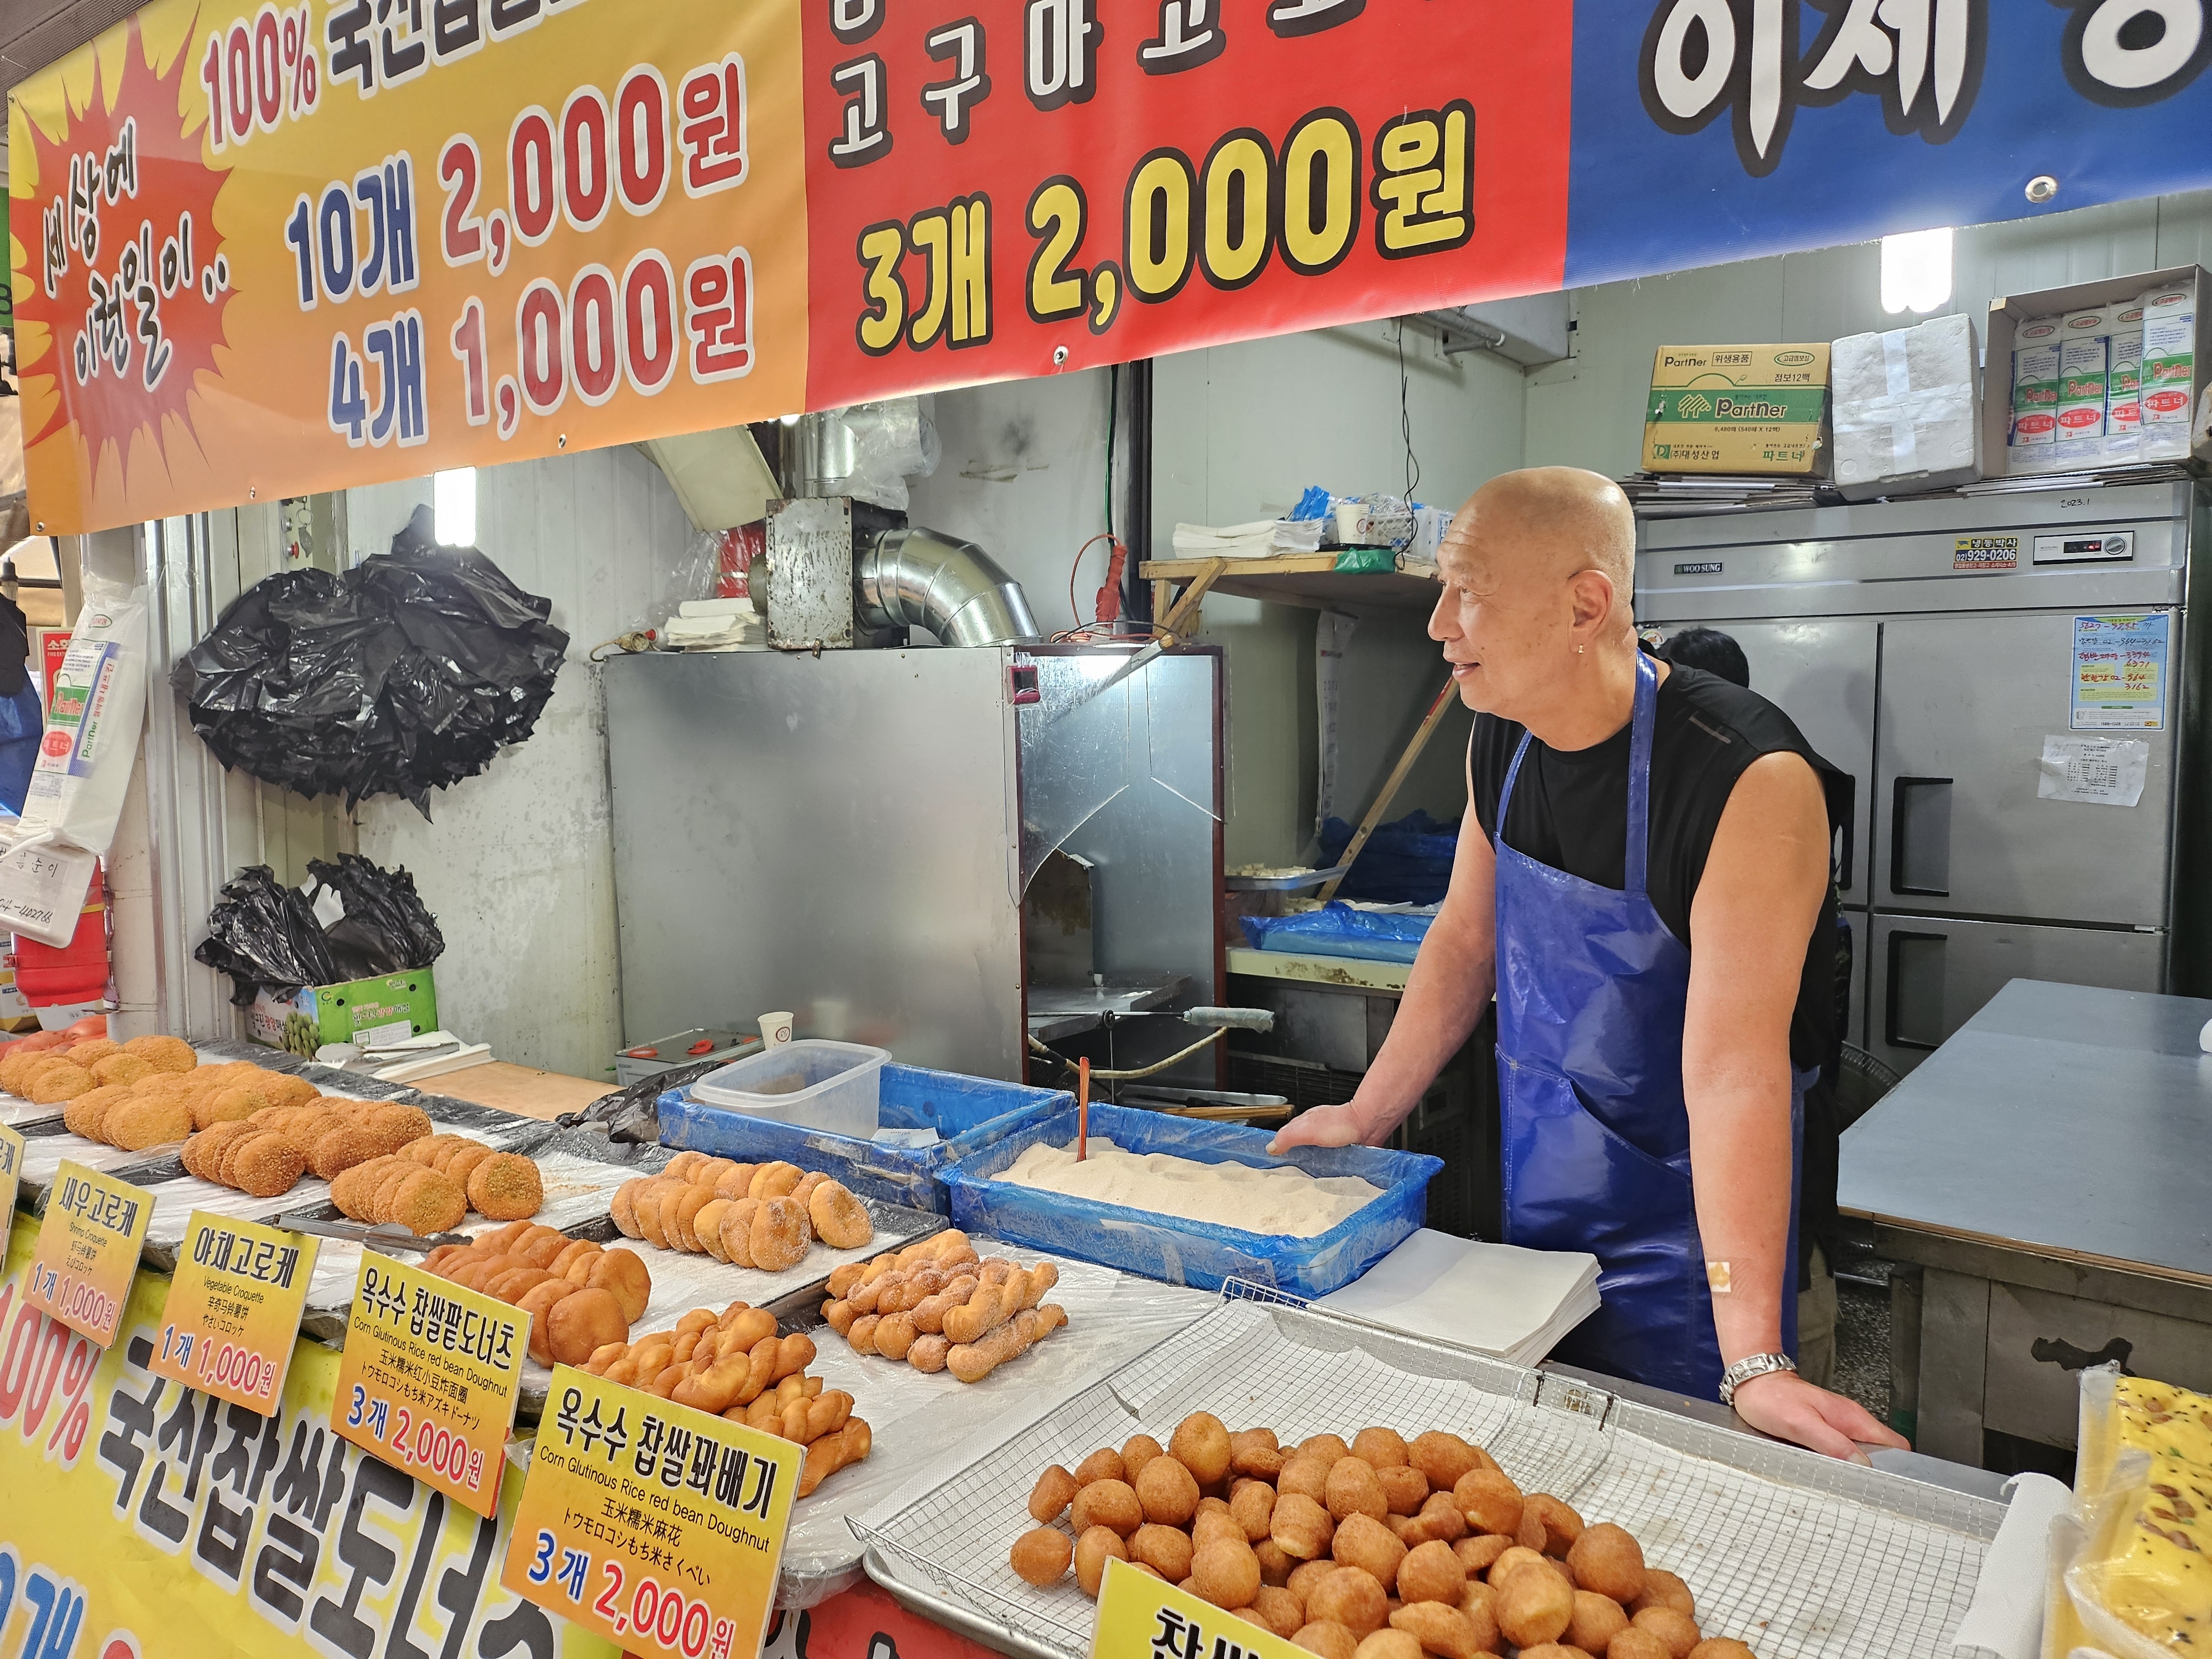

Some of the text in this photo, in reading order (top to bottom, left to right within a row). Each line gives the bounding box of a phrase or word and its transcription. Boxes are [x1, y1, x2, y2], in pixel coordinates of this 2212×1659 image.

[203, 10, 315, 146] 100%
[288, 62, 743, 303] 10개 2,000원
[860, 109, 1466, 349] 3개 2,000원
[335, 256, 749, 440] 4개 1,000원
[1665, 356, 1707, 367] Partner
[1714, 354, 1749, 363] 위생용품
[2153, 362, 2192, 380] Partner
[1714, 398, 1787, 418] Partner
[2114, 408, 2139, 418] 파트
[2146, 396, 2184, 408] 파트너
[2018, 420, 2053, 430] 파트너
[2060, 413, 2096, 425] 파트너
[1670, 450, 1719, 460] (주)대성산업
[1762, 451, 1802, 462] 파트너
[2061, 498, 2090, 508] 2023.1
[1971, 538, 2018, 549] 냉동박사
[1683, 563, 1721, 573] WOO SUNG
[47, 639, 69, 651] 소화
[81, 721, 97, 758] Partner
[59, 1176, 138, 1238] 새우고로케
[69, 1222, 107, 1248] Shrimp Croquette
[193, 1227, 299, 1289] 야채고로케
[58, 1277, 116, 1332] 1,000원
[204, 1276, 264, 1304] Vegetable Croquette
[362, 1267, 406, 1326] 옥수수
[202, 1313, 245, 1337] やさいコロッケ
[0, 1282, 102, 1460] 00%
[199, 1339, 276, 1396] 1,000원
[354, 1317, 508, 1398] Corn Glutinous Rice red bean Doughnut
[392, 1409, 483, 1489] 2,000원
[557, 1387, 777, 1519] 옥수수 찹쌀꽈배기
[540, 1445, 770, 1553] Corn Glutinous Rice red bean Doughnut
[601, 1496, 683, 1548] 玉米糯米麻花
[595, 1564, 734, 1659] 2,000원
